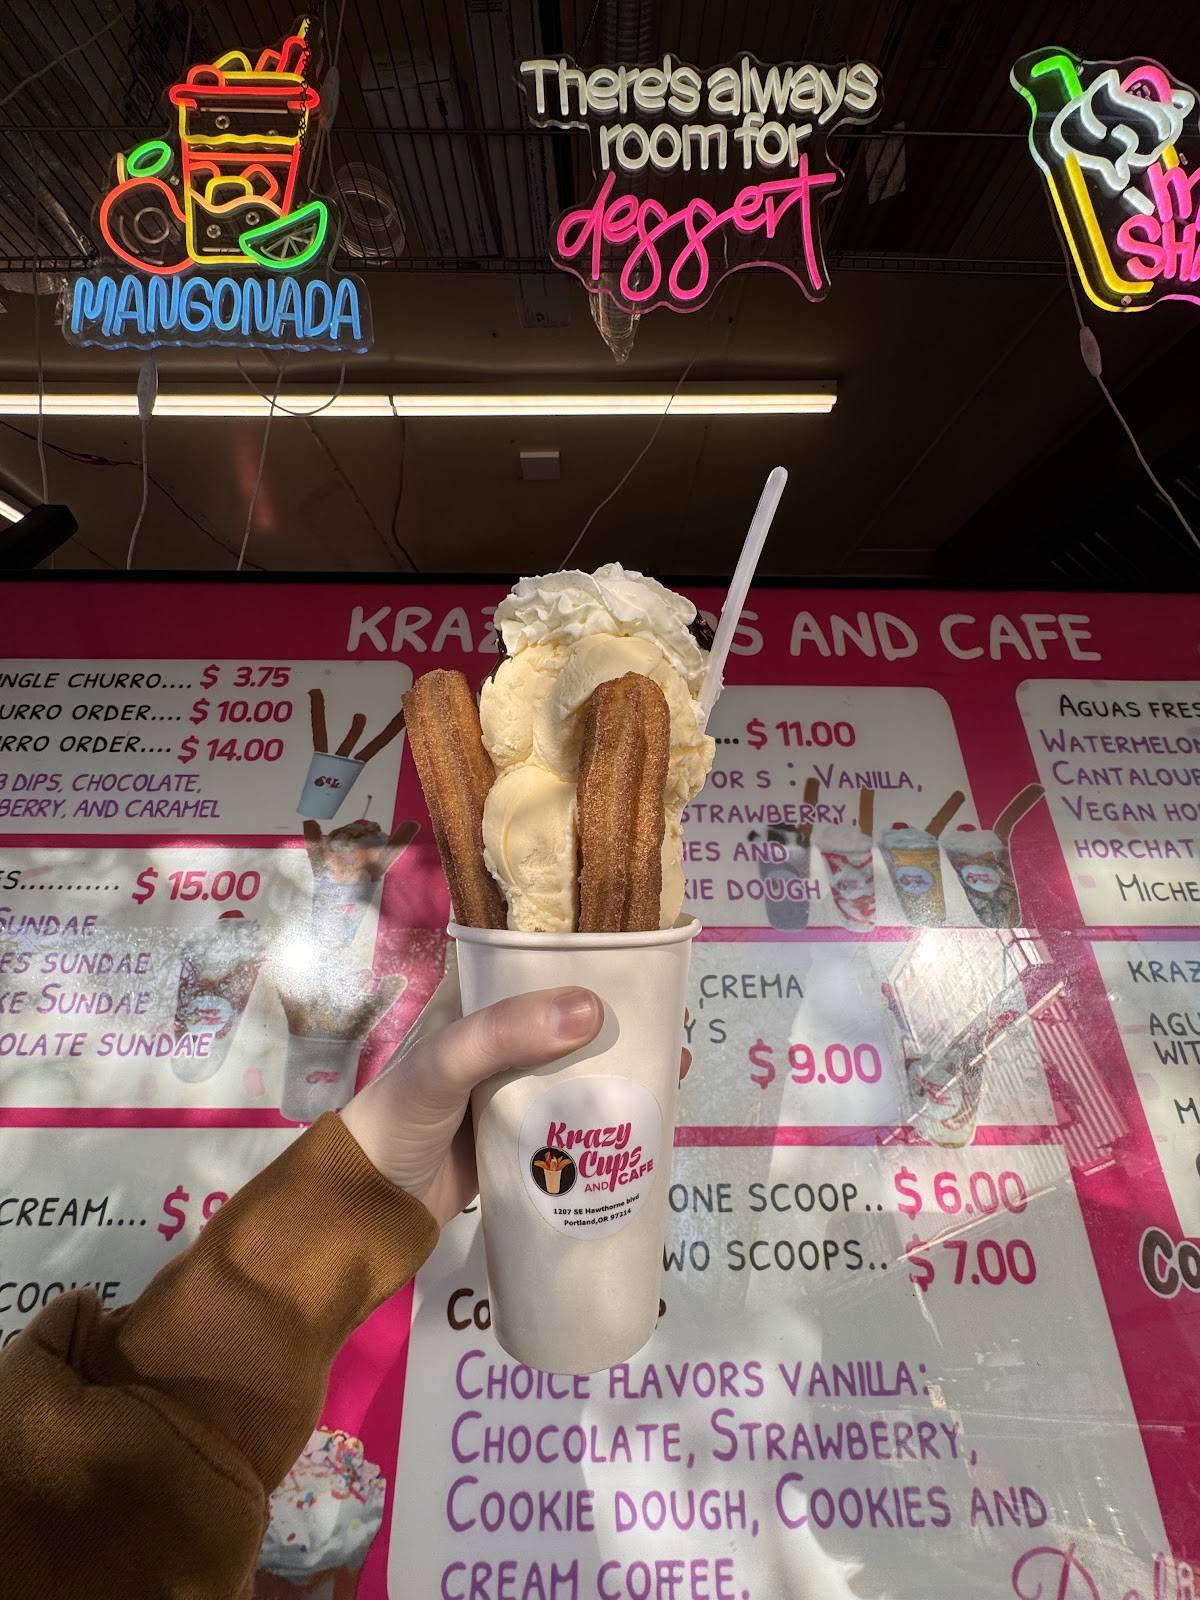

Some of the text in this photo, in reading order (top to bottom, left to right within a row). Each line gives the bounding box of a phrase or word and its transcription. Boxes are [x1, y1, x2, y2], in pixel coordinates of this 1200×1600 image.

[520, 55, 878, 124] There's always
[600, 112, 812, 170] room for
[557, 153, 836, 300] dessert
[71, 276, 362, 340] MANGONADA
[790, 611, 918, 660] AND
[939, 613, 1101, 660] CAFE
[200, 664, 220, 690] $
[233, 667, 291, 688] 3.75
[189, 698, 209, 725] $
[218, 701, 292, 722] 10.00
[1059, 694, 1141, 718] AGUAS
[178, 736, 200, 764] $
[207, 739, 284, 761] 14.00
[746, 718, 856, 750] $ 11.00
[12, 773, 63, 793] DIPS,
[72, 773, 202, 793] CHOCOLATE,
[74, 800, 119, 818] AND
[125, 800, 220, 818] CARAMEL
[1061, 796, 1200, 822] VEGAN HO
[733, 842, 788, 862] AND
[132, 867, 159, 905] $
[168, 871, 261, 901] 15.00
[727, 879, 822, 900] DOUGH
[41, 952, 152, 975] SUNDAE
[36, 983, 151, 1015] SUNDAE
[97, 1033, 216, 1057] SUNDAE
[748, 1038, 882, 1090] $ 9.00
[547, 1121, 632, 1150] Krazy
[578, 1146, 642, 1193] Cups
[584, 1158, 654, 1193] AND CAFE
[553, 1208, 572, 1216] 1207
[585, 1201, 626, 1214] Hawthorne
[668, 1183, 734, 1213] ONE
[894, 1166, 923, 1219] $
[934, 1171, 1028, 1215] 6.00
[158, 1185, 190, 1242] $
[610, 1208, 632, 1221] 97214
[909, 1234, 936, 1291] $
[943, 1239, 1037, 1285] 7.00
[451, 1407, 977, 1469] CHOCOLATE, STRAWBERRY,
[446, 1472, 1048, 1538] COOKIE DOUGH, COOKIES AND
[440, 1558, 579, 1600] CREAM
